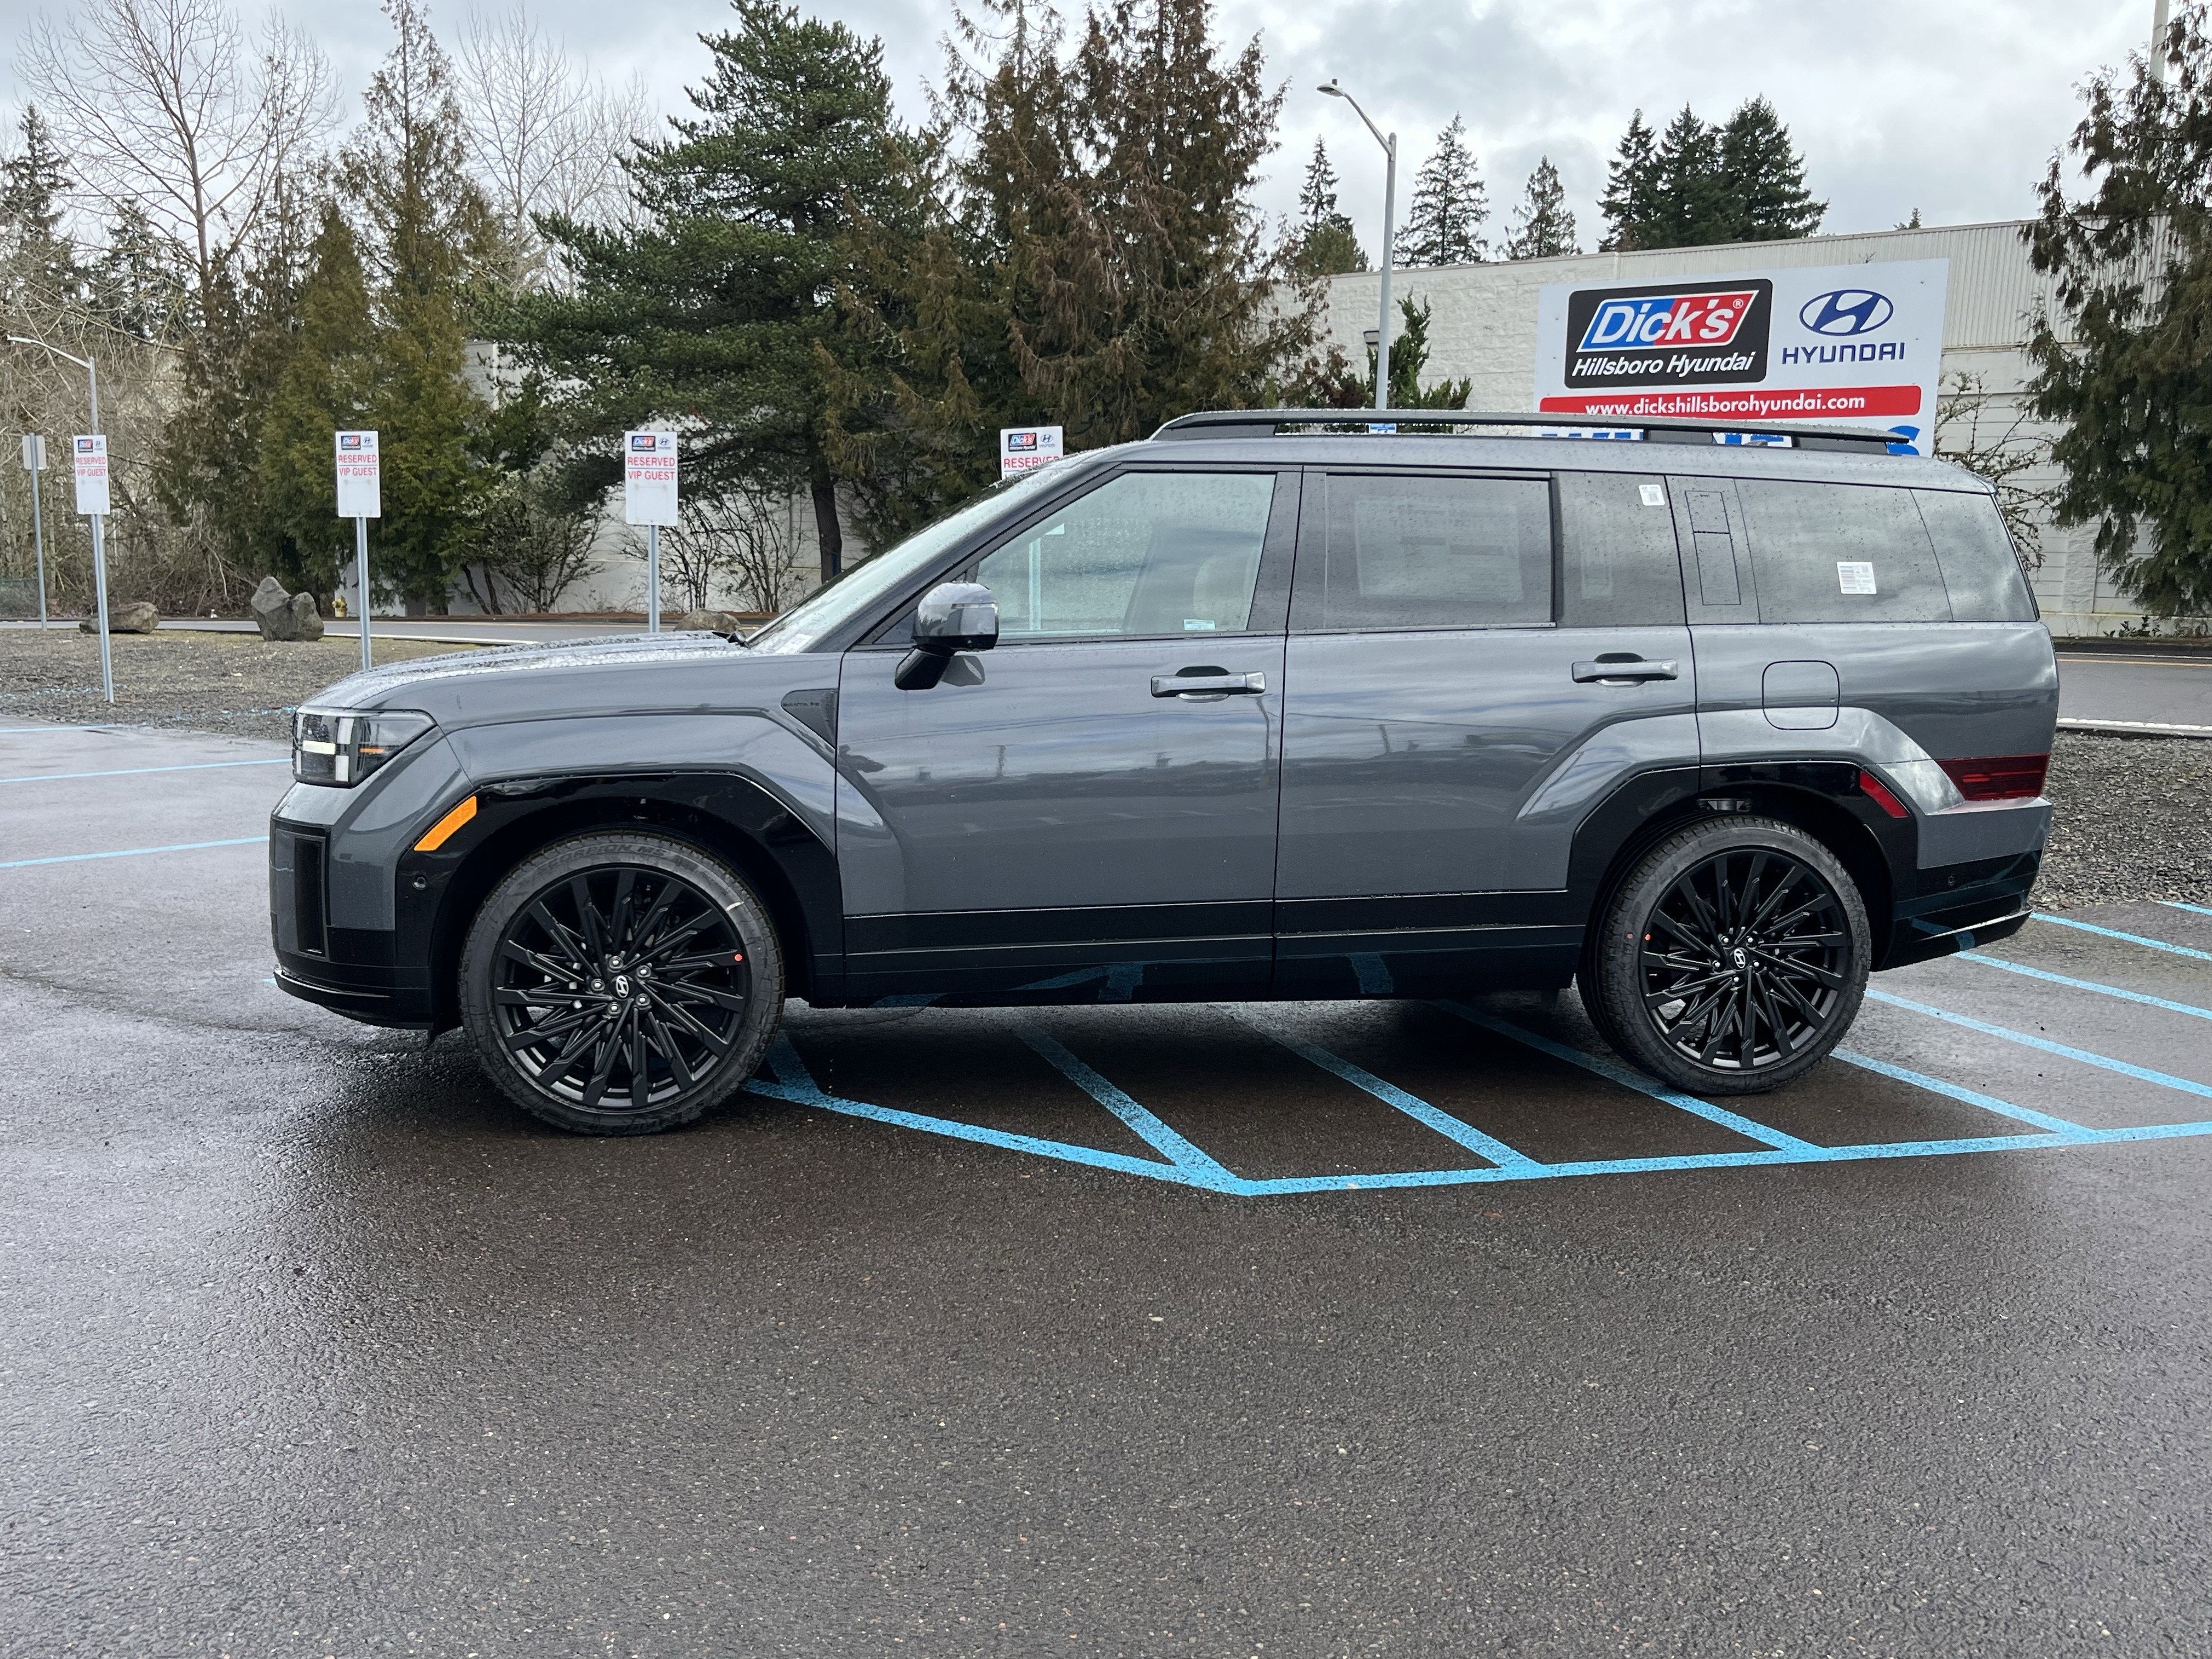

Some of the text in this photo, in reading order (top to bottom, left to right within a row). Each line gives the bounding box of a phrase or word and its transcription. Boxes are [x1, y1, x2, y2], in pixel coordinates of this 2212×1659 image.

[1591, 299, 1734, 343] Dick's
[1782, 342, 1905, 364] HYUNDAI
[1572, 352, 1756, 377] Hillsboro Hyundai
[1585, 393, 1865, 416] www.dickshillsborohyundai.com
[338, 455, 377, 463] RESERVED
[628, 457, 675, 466] RESERVED
[339, 467, 377, 476] VIP GUEST
[628, 471, 675, 480] VIP GUEST
